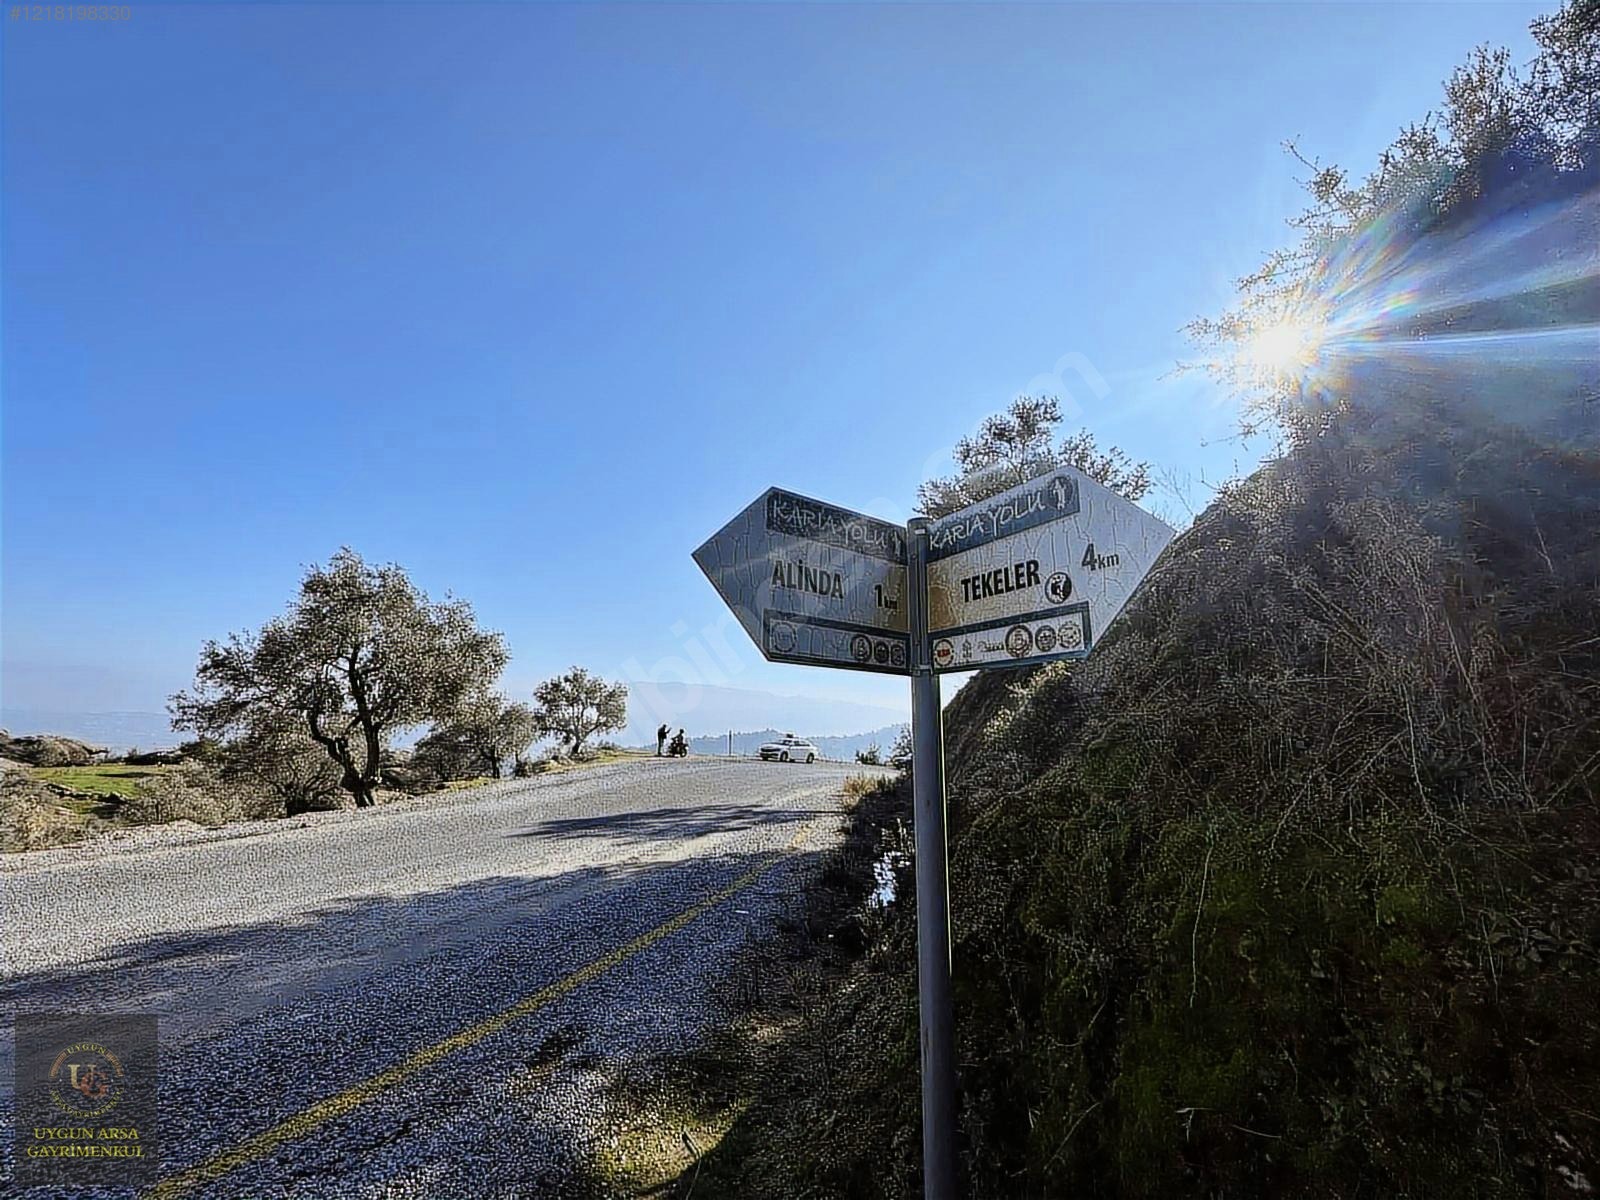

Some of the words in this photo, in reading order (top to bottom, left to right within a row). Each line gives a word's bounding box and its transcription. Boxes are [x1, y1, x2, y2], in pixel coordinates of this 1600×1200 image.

[988, 490, 1046, 537] YOLU
[771, 559, 844, 600] ALİNDA
[961, 559, 1041, 602] TEKELER
